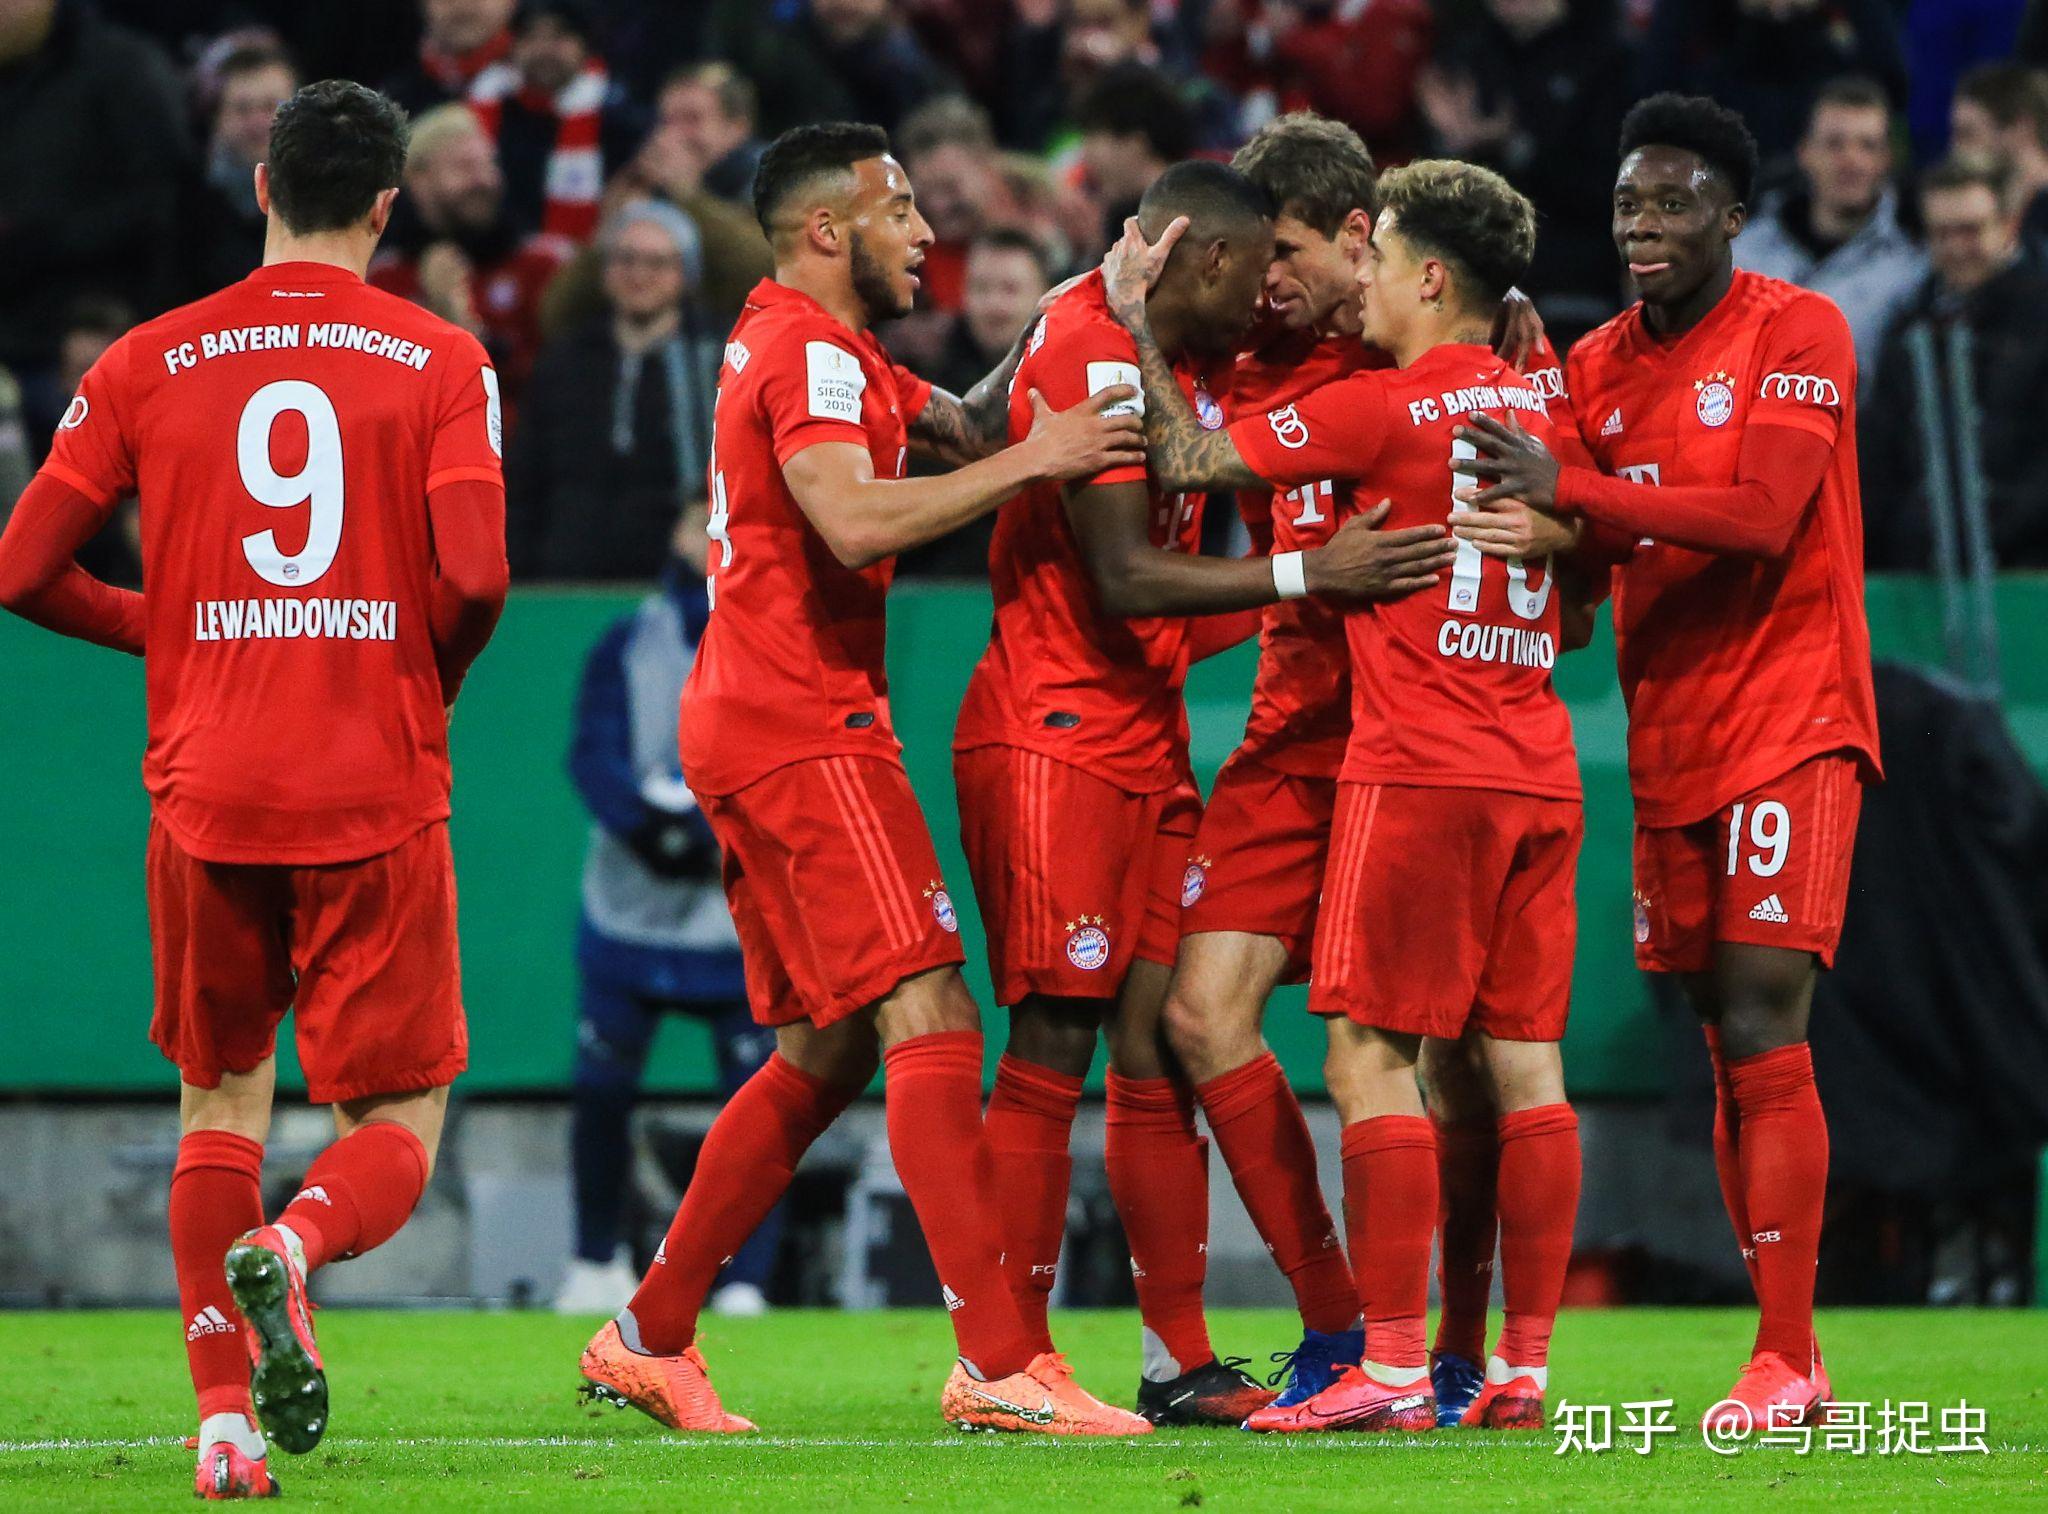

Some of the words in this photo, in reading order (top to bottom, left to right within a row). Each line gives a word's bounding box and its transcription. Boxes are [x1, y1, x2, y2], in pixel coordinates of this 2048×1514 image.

[163, 342, 199, 376] FC
[200, 323, 300, 360] BAYERN
[306, 323, 432, 371] MÜNCHEN
[824, 400, 853, 413] 2019
[1408, 398, 1440, 426] FC
[236, 379, 345, 588] 9
[195, 598, 397, 641] LEWANDOWSKI
[1437, 619, 1555, 669] COUTINHO
[1726, 800, 1791, 877] 19
[1749, 909, 1789, 924] adidas
